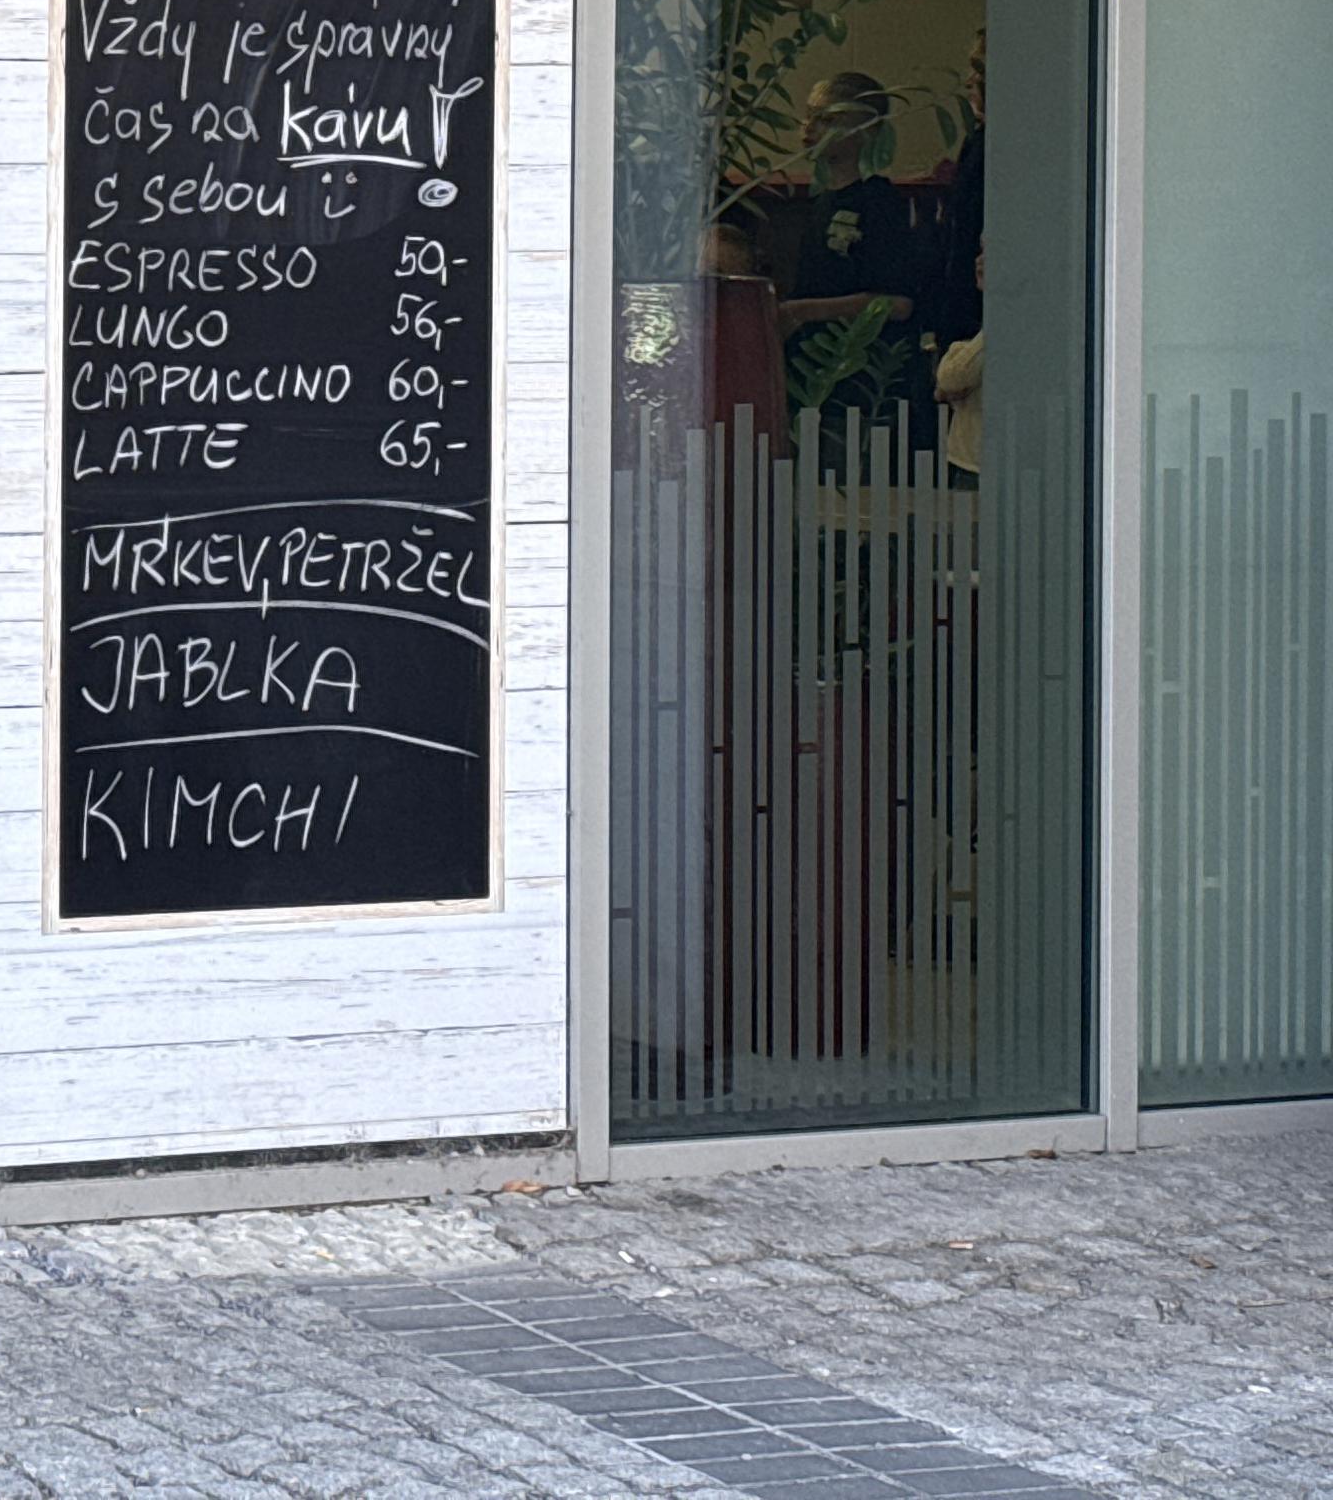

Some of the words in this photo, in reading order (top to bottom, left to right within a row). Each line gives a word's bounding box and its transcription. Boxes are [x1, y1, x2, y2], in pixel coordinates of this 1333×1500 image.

[223, 3, 268, 84] je
[191, 103, 260, 142] na
[140, 161, 286, 224] sebou
[68, 239, 318, 293] ESPRESSO
[393, 235, 469, 286] 50,-
[68, 302, 229, 351] LUNGO
[389, 293, 463, 351] 56,-
[70, 360, 351, 412] CAPPUCCINO
[387, 362, 469, 409] 60,-
[73, 423, 249, 480] LATTE
[379, 420, 469, 476] 65,-
[80, 632, 361, 715] JABLKA
[81, 768, 361, 862] KIMCHI
